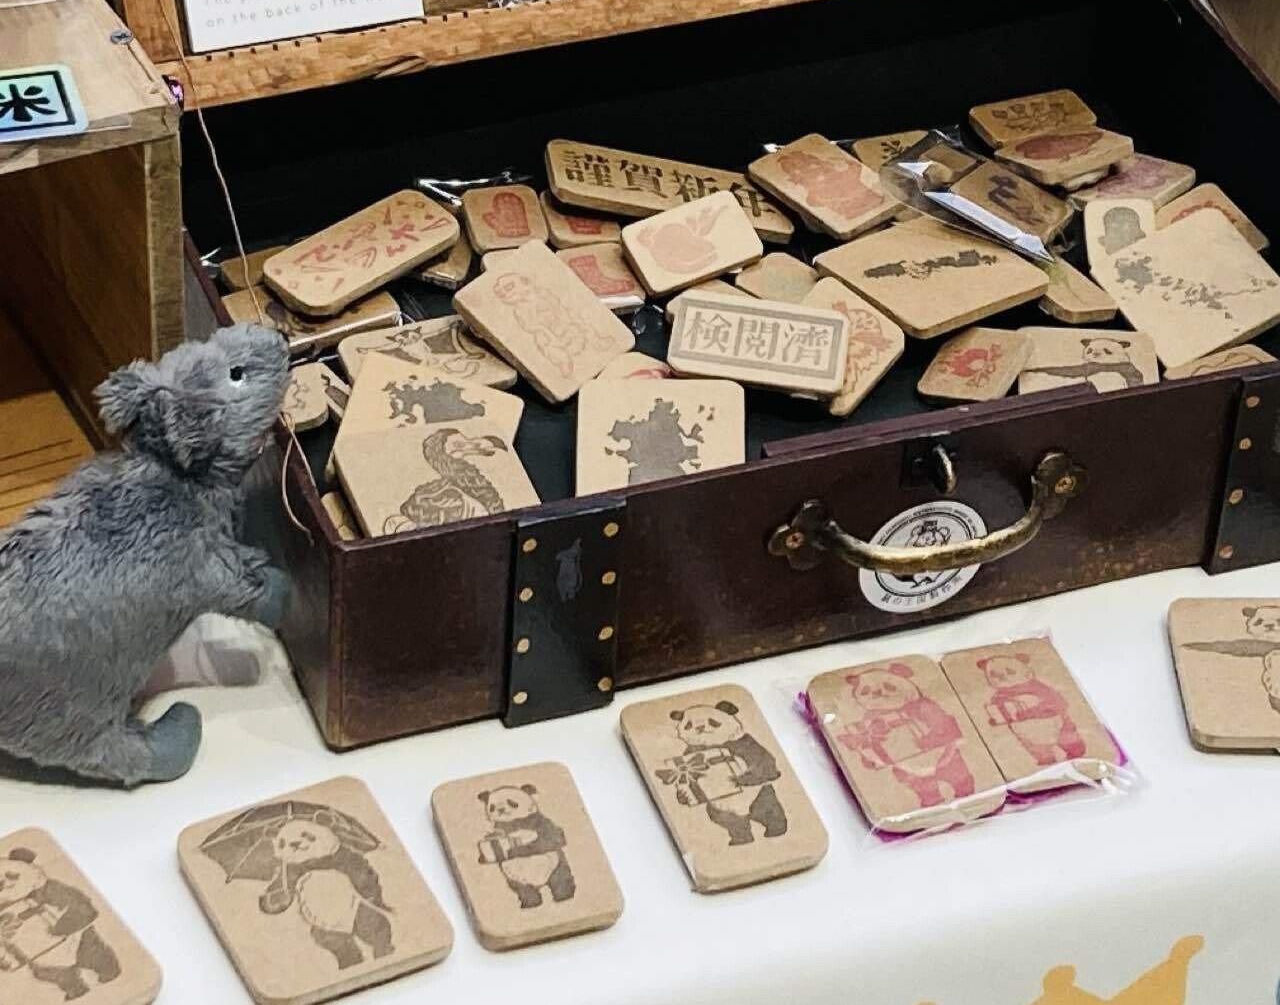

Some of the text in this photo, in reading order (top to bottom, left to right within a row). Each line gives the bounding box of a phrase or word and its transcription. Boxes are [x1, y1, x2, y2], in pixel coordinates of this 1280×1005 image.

[206, 16, 225, 28] on
[232, 8, 257, 23] the
[266, 1, 301, 19] back
